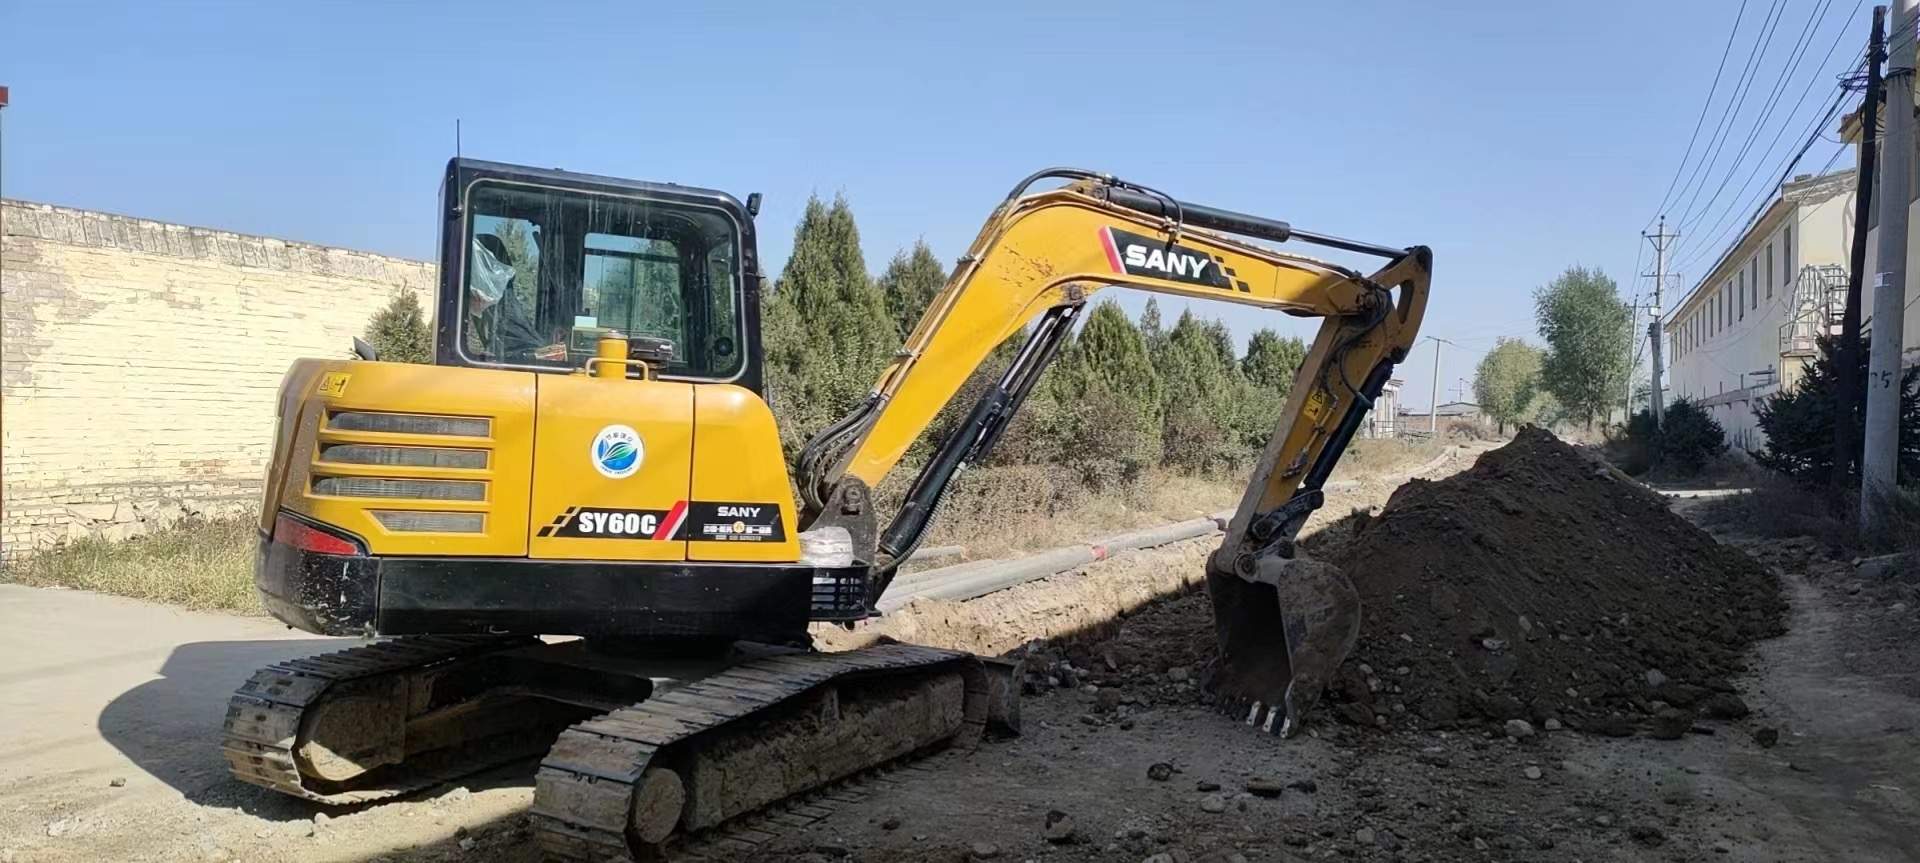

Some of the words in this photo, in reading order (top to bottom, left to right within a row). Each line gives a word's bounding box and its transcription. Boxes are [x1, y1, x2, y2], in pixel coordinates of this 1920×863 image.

[1125, 244, 1209, 278] SANY
[578, 512, 656, 535] SY60C
[717, 506, 760, 518] SANY
